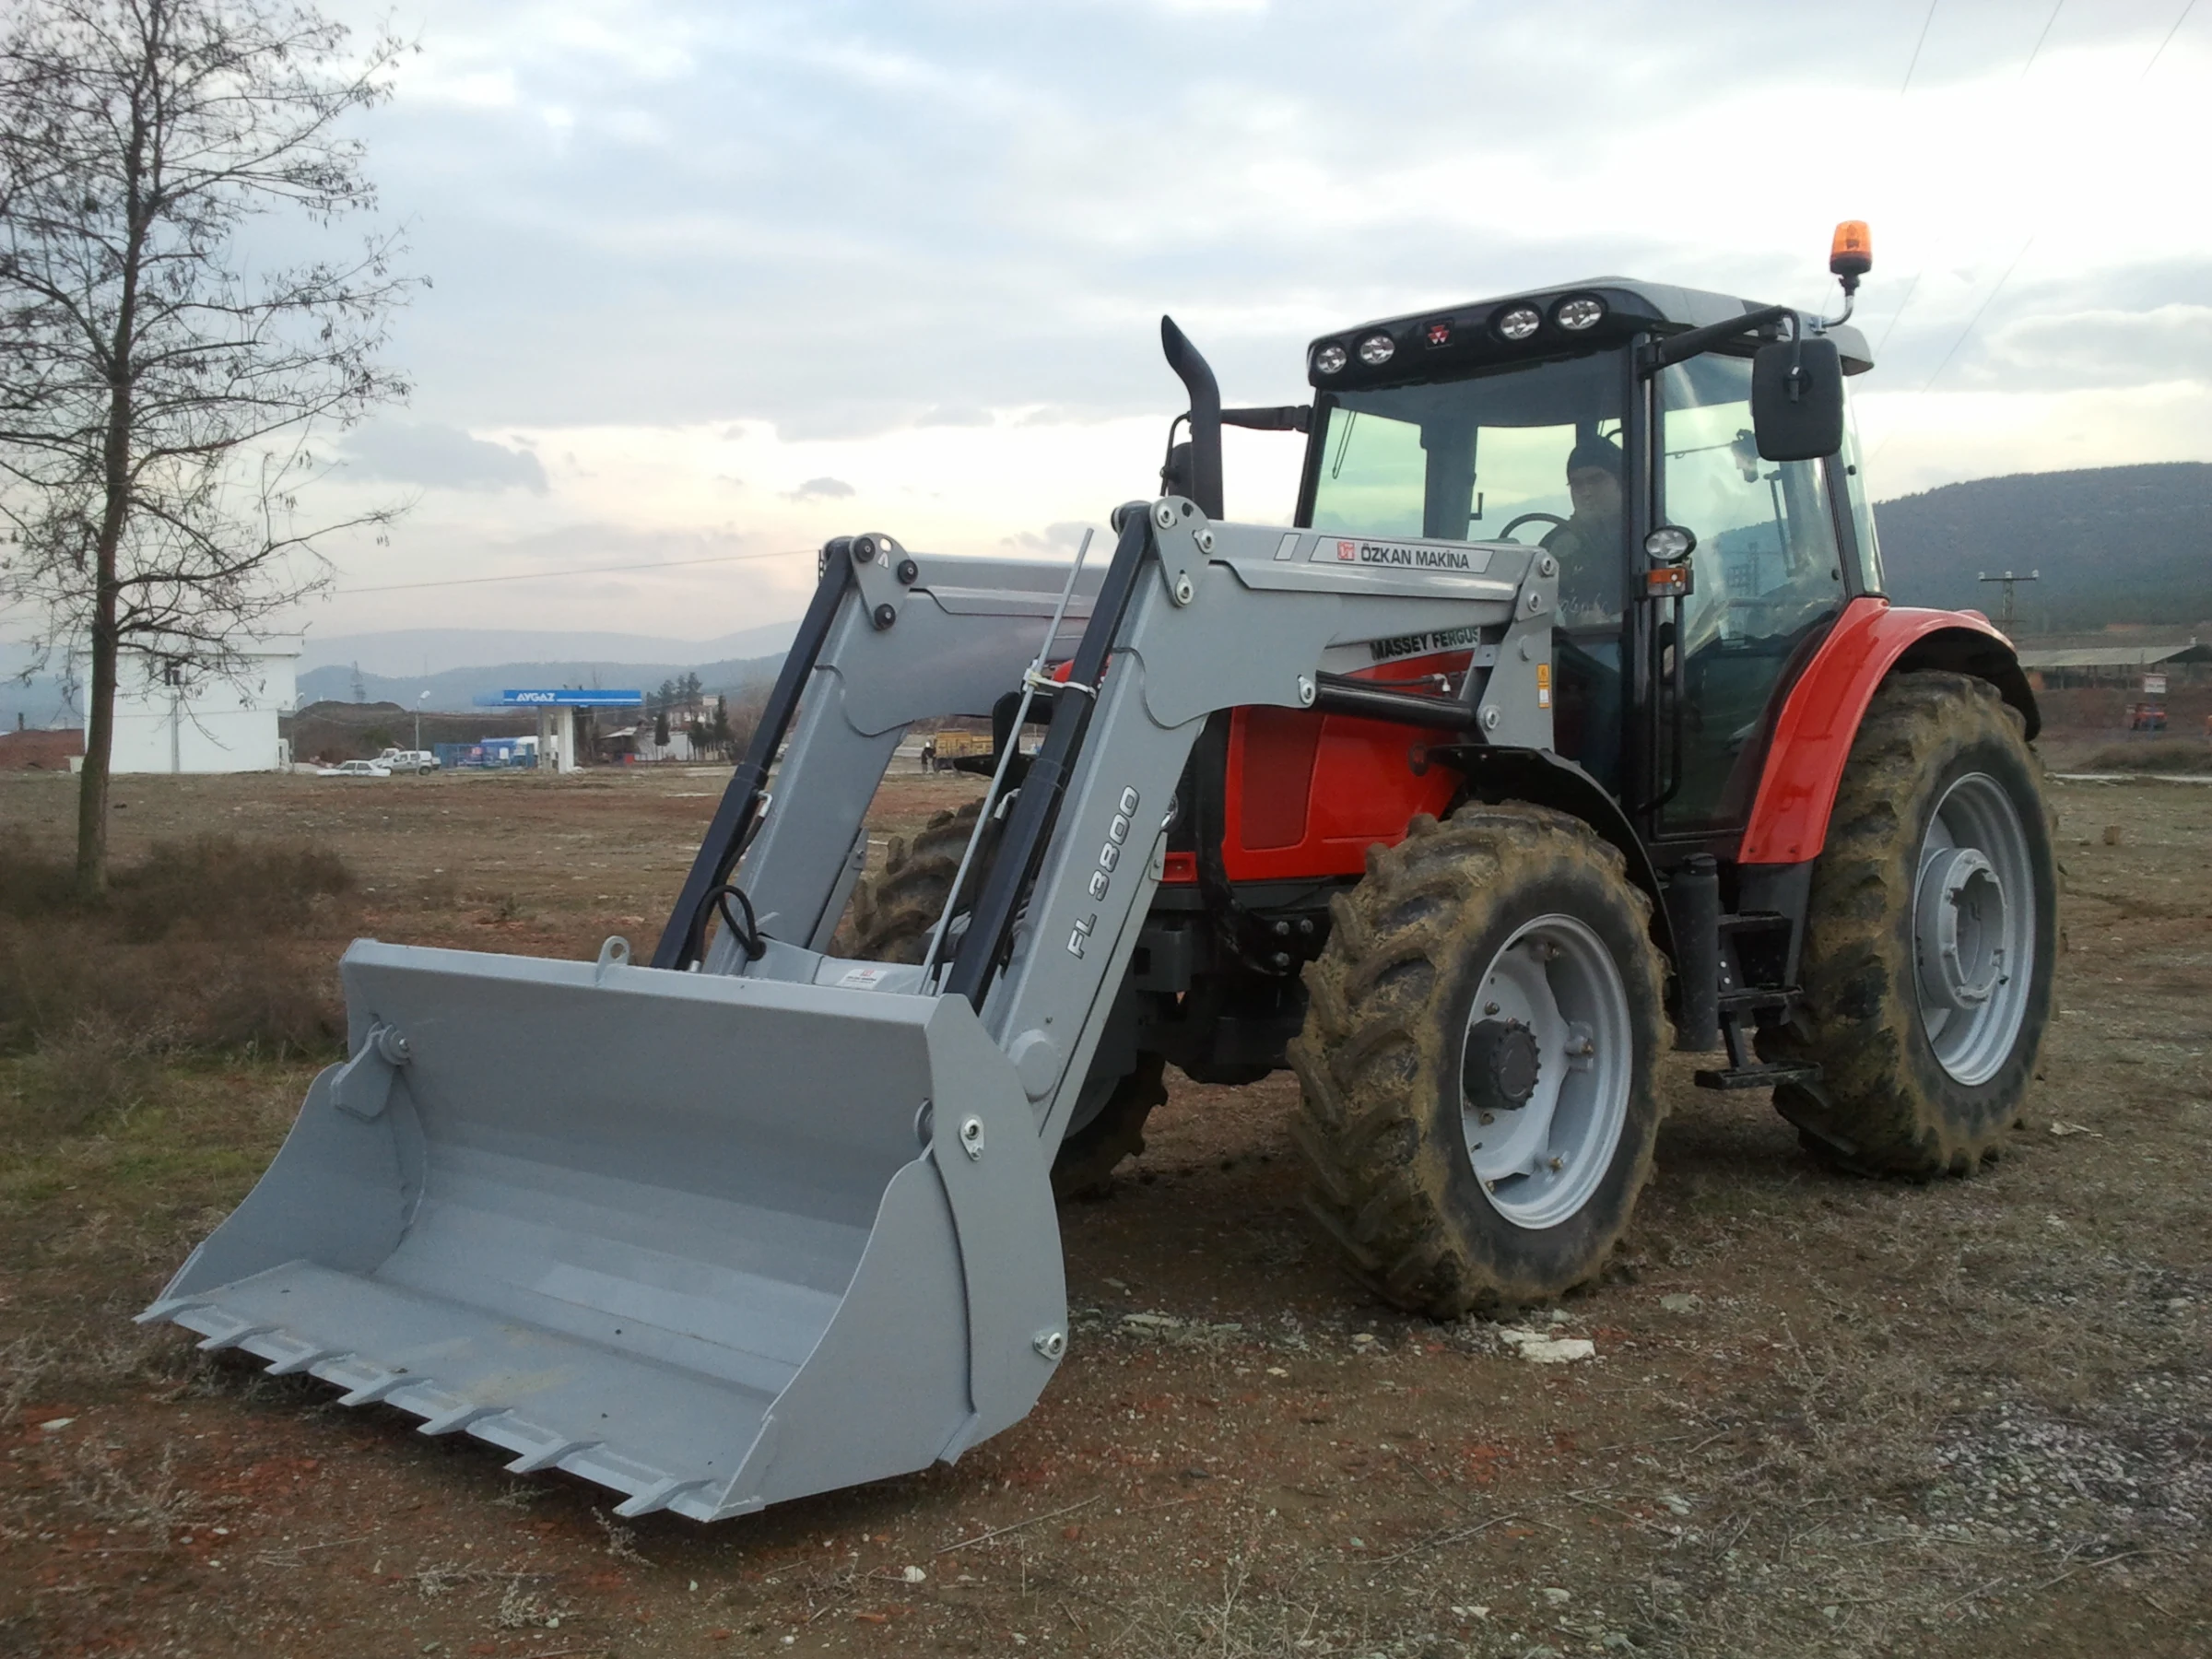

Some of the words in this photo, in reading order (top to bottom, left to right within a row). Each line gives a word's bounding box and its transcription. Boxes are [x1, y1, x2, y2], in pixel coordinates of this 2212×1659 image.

[1360, 543, 1412, 565] ÖZKAN
[1416, 549, 1470, 569] MAKİNA
[1370, 633, 1428, 662] MASSEY
[516, 692, 555, 702] AYGAZ
[1066, 913, 1097, 959] FL
[1088, 785, 1140, 901] 3800
